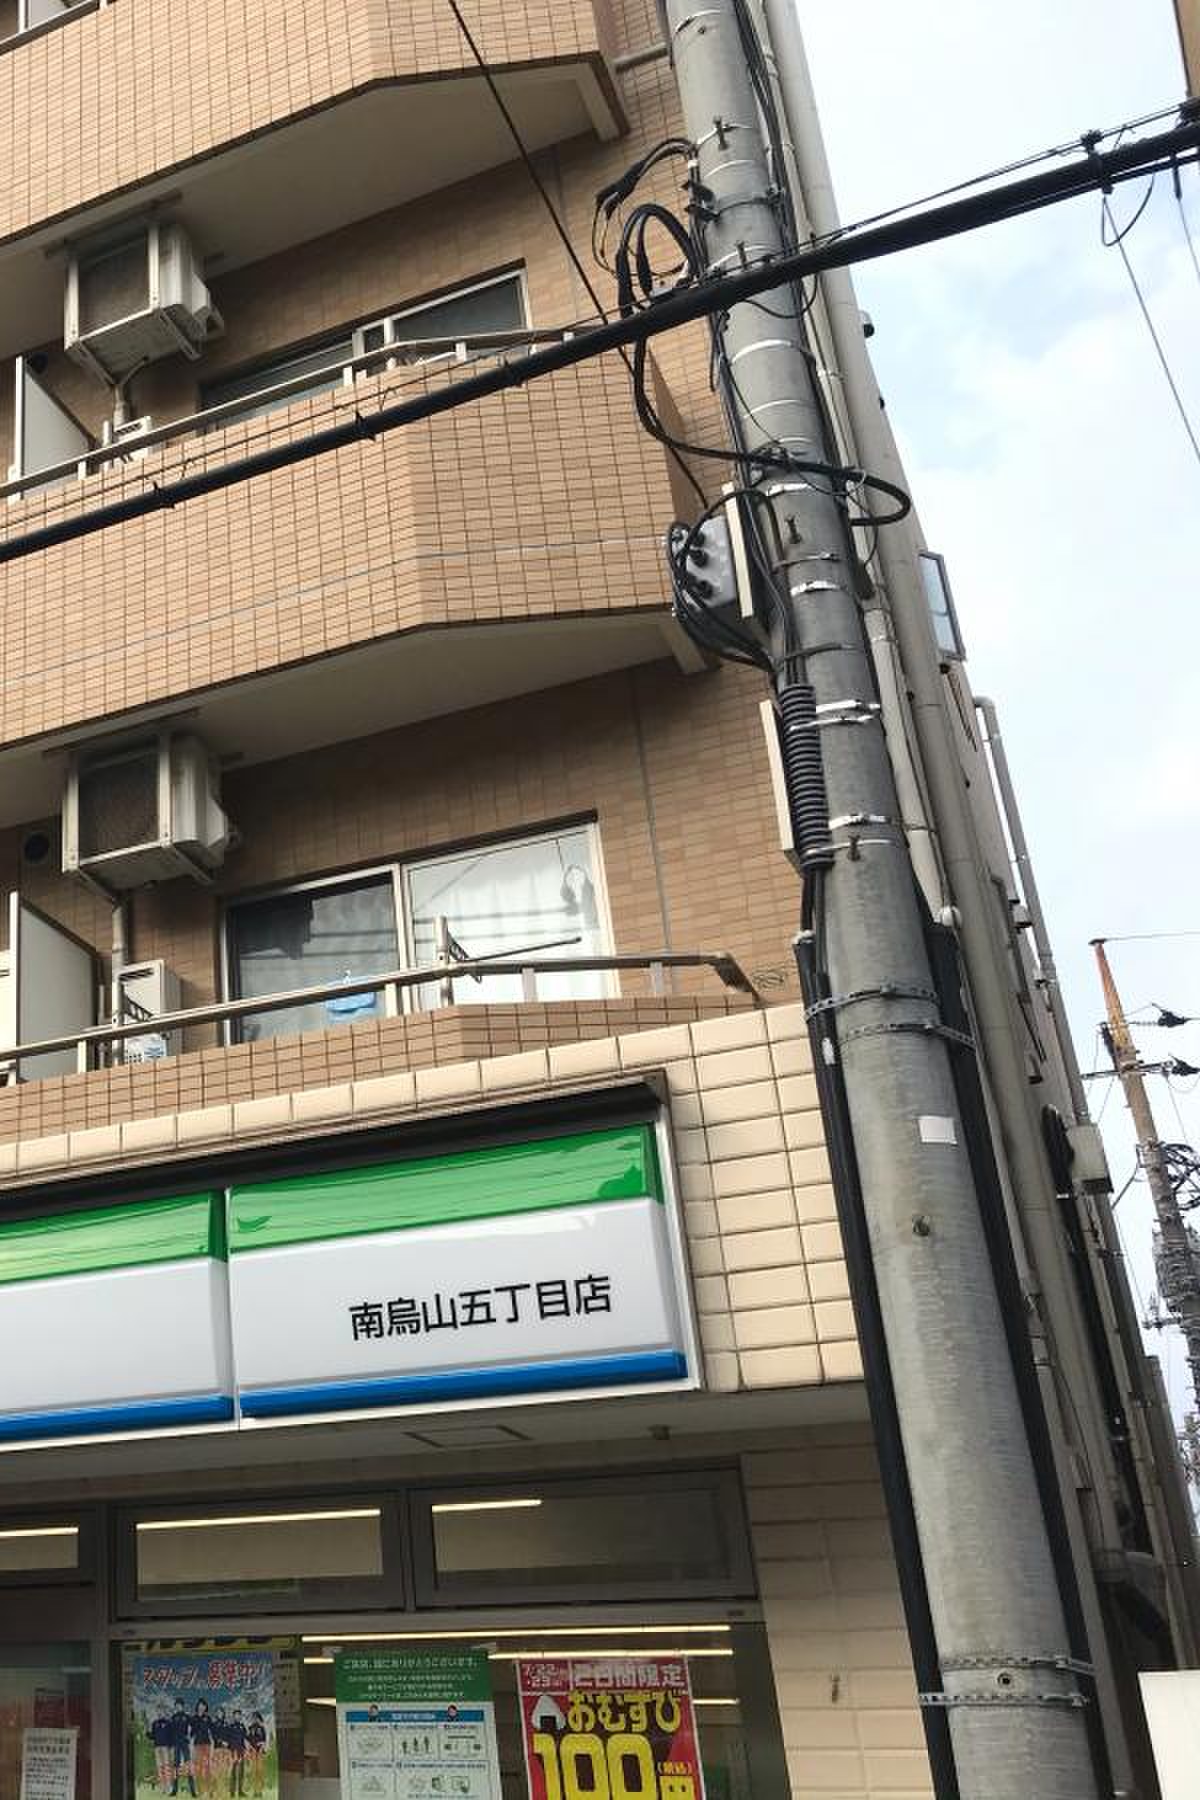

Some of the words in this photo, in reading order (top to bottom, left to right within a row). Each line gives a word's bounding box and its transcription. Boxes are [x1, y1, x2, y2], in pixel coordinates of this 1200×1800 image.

[348, 1274, 612, 1341] 南烏山五丁目店
[567, 1689, 682, 1734] おむすび
